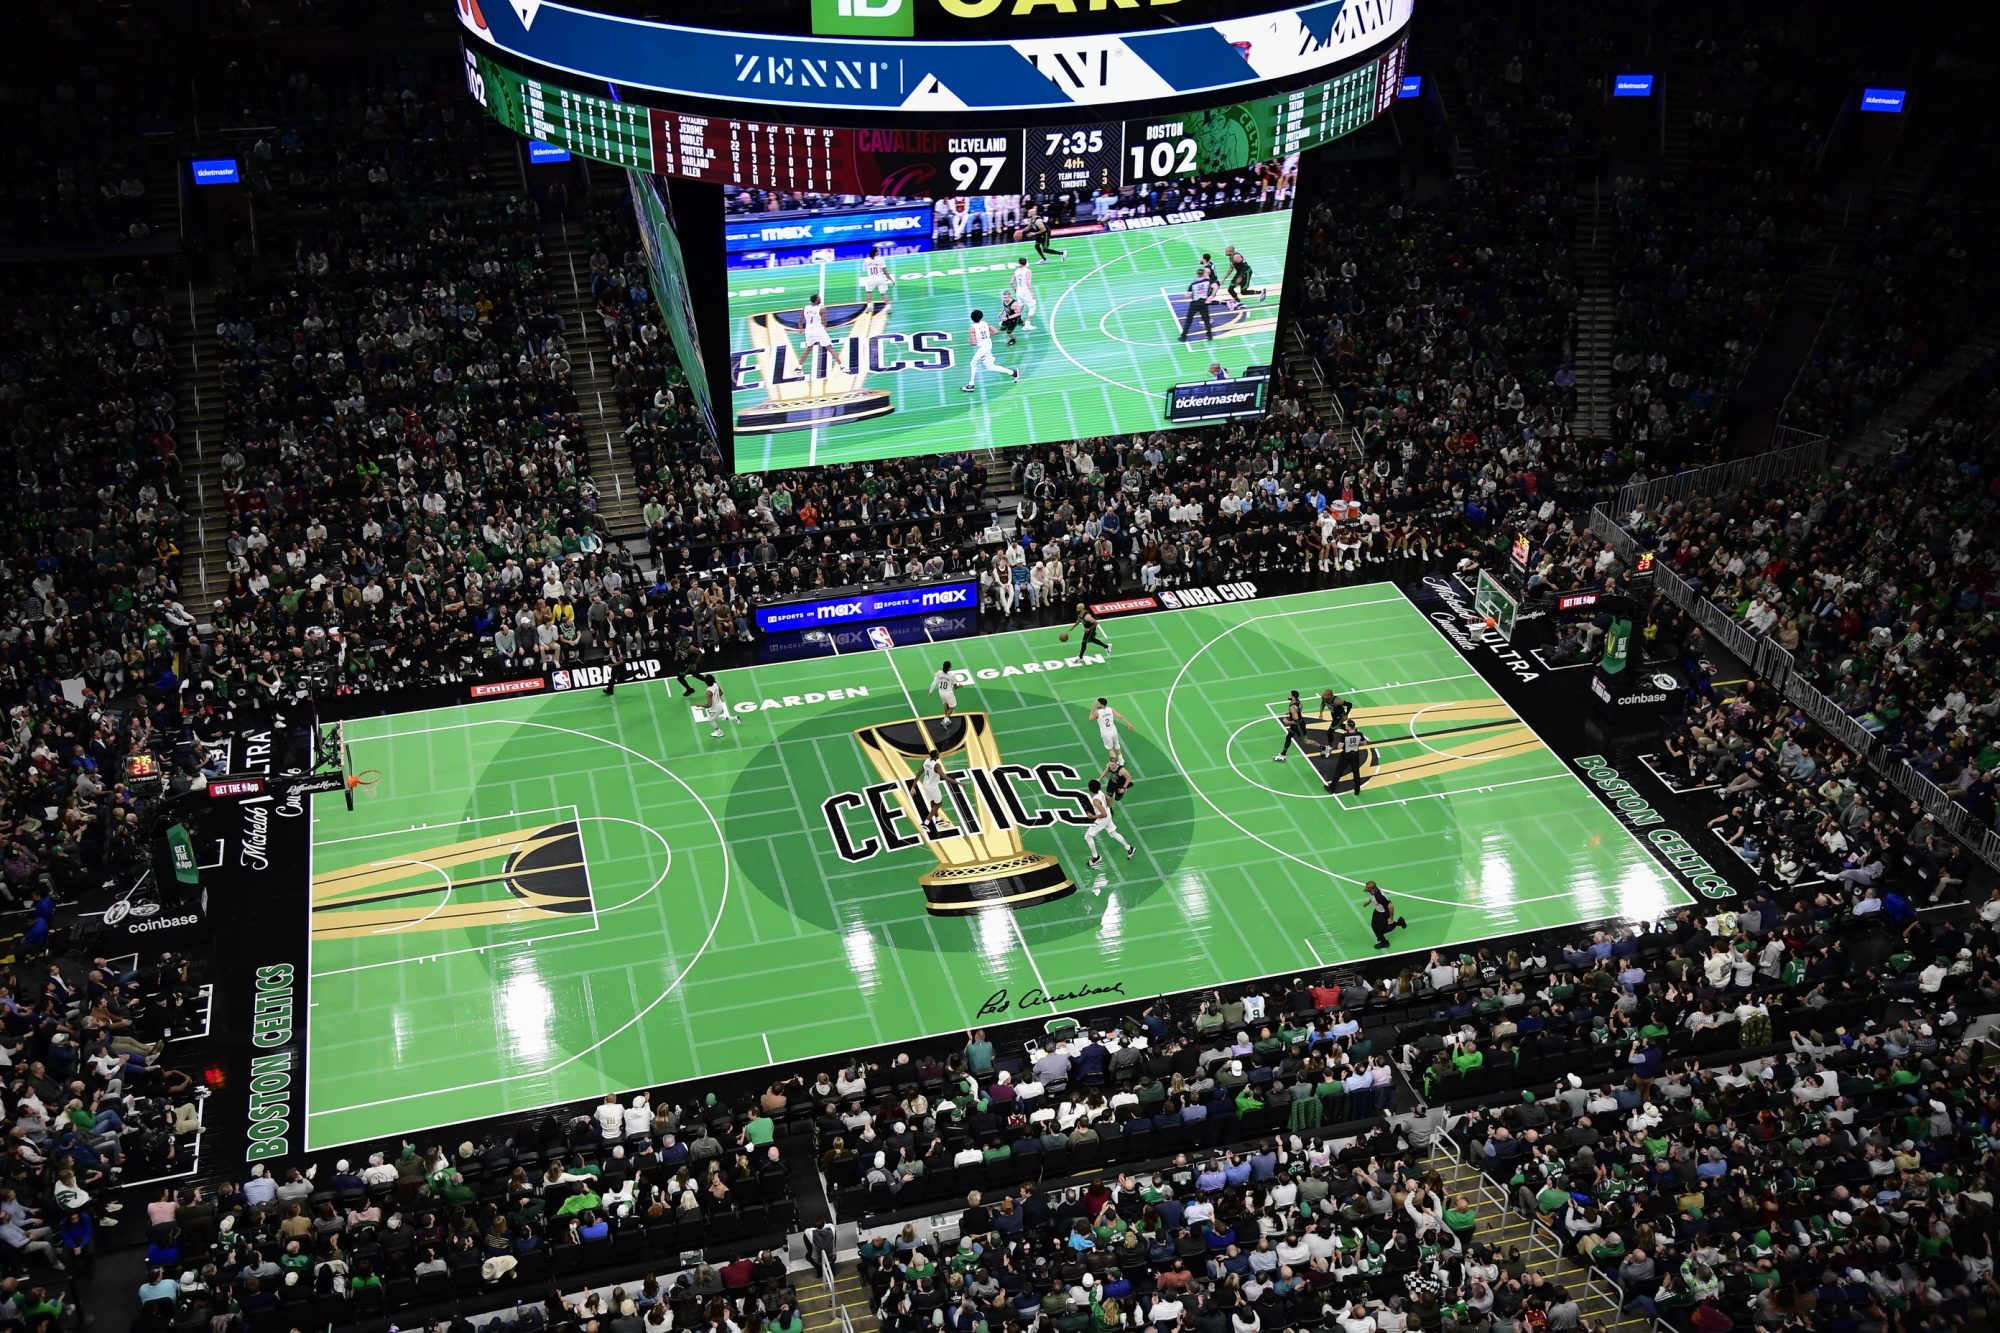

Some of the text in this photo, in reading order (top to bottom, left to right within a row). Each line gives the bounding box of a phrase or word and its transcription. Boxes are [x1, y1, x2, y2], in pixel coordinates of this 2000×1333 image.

[735, 54, 878, 90] ZENNI
[730, 122, 740, 130] PTS
[1146, 122, 1184, 140] BOSTON
[679, 124, 704, 136] JEROME
[769, 134, 774, 143] 5
[825, 138, 830, 147] 2
[1046, 130, 1102, 156] 7:35
[731, 141, 740, 150] 22
[948, 138, 1006, 153] CLEVELAND
[681, 145, 703, 158] PORTER
[705, 149, 716, 159] JR.
[732, 152, 740, 161] 12
[752, 154, 757, 163] 3
[770, 156, 775, 165] 3
[1064, 158, 1084, 169] 4th
[1131, 139, 1198, 178] 102
[668, 163, 674, 173] 31
[682, 166, 701, 177] ALLEN
[734, 173, 741, 183] 10
[753, 175, 758, 184] 11
[771, 177, 776, 186] 2
[681, 156, 709, 168] GARLAND
[734, 163, 739, 172] 6
[753, 165, 757, 174] 2
[771, 167, 775, 176] 7
[950, 156, 1007, 190] 97
[1058, 172, 1072, 180] TEAM
[1074, 171, 1089, 180] FOULS
[1102, 168, 1108, 176] 3
[1061, 179, 1086, 188] TIMEOUTS
[1102, 177, 1108, 185] 3
[874, 216, 922, 232] max
[1126, 210, 1205, 230] NBA CUP
[762, 226, 813, 241] max
[1175, 392, 1250, 409] ticketmaster
[1638, 560, 1649, 570] 23
[884, 599, 909, 608] SPORTS
[922, 588, 967, 605] max
[1176, 582, 1258, 606] NBA CUP
[1564, 595, 1595, 607] GET THE App
[778, 612, 804, 621] SPORTS
[817, 602, 862, 619] max
[1095, 598, 1151, 612] Emirates
[1481, 632, 1539, 682] ULTRA
[977, 654, 1105, 679] GARDEN
[475, 679, 540, 695] Emirates
[939, 681, 948, 690] 10
[734, 686, 868, 713] GARDEN
[1618, 693, 1666, 705] coinbase
[1105, 719, 1110, 727] 2
[133, 764, 149, 774] 23
[215, 782, 259, 795] GET THE App
[821, 763, 1098, 863] CELTICS
[1574, 754, 1737, 899] BOSTON CELTICS
[240, 806, 268, 870] Michelob
[174, 845, 186, 853] GET
[182, 861, 192, 869] App
[129, 915, 198, 933] coinbase
[1253, 1010, 1260, 1020] 9
[247, 963, 294, 1162] BOSTON CELTICS
